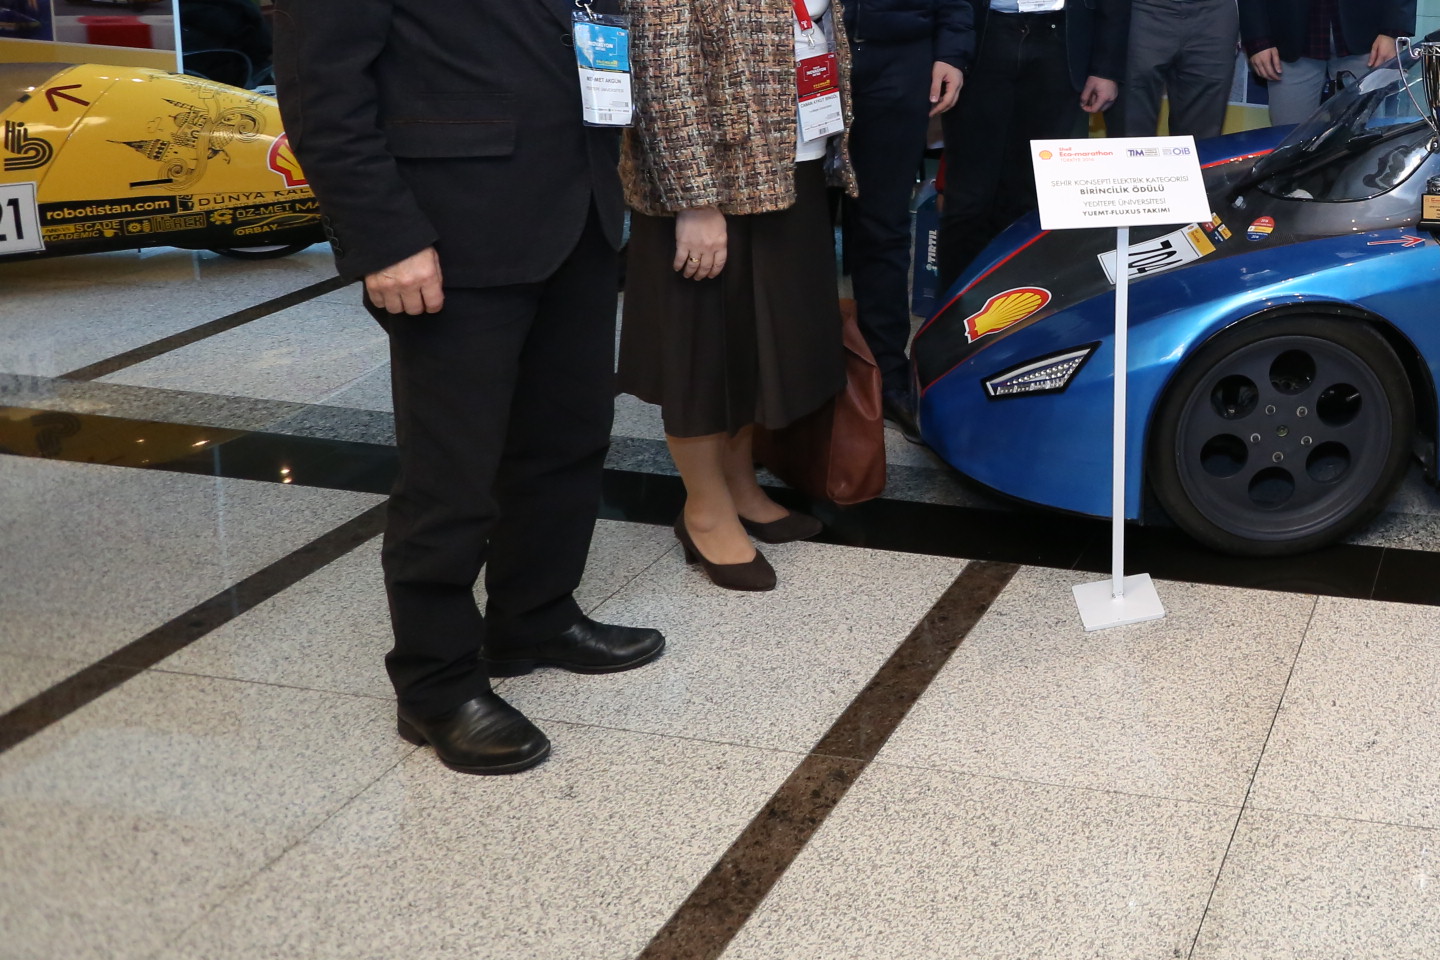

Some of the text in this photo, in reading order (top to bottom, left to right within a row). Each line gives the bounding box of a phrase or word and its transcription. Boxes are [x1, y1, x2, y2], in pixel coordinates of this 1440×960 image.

[1060, 150, 1113, 158] Eco-marathon
[1074, 178, 1111, 186] KONSEPTİ
[1080, 185, 1165, 195] BİRİNCİLİK ÖDÜLÜ
[198, 192, 264, 206] DÜNYA
[1083, 197, 1166, 207] YEDİTEPE ÜNİVERSİTESİ
[46, 200, 170, 220] robotistan.com
[236, 204, 290, 217] ÖZ-MET
[1083, 208, 1141, 216] YUEMT-FLUXUS
[75, 221, 121, 233] SCADE
[237, 224, 279, 236] ORBAY
[43, 230, 100, 242] ACADEMIC
[928, 230, 937, 263] TIRTIL
